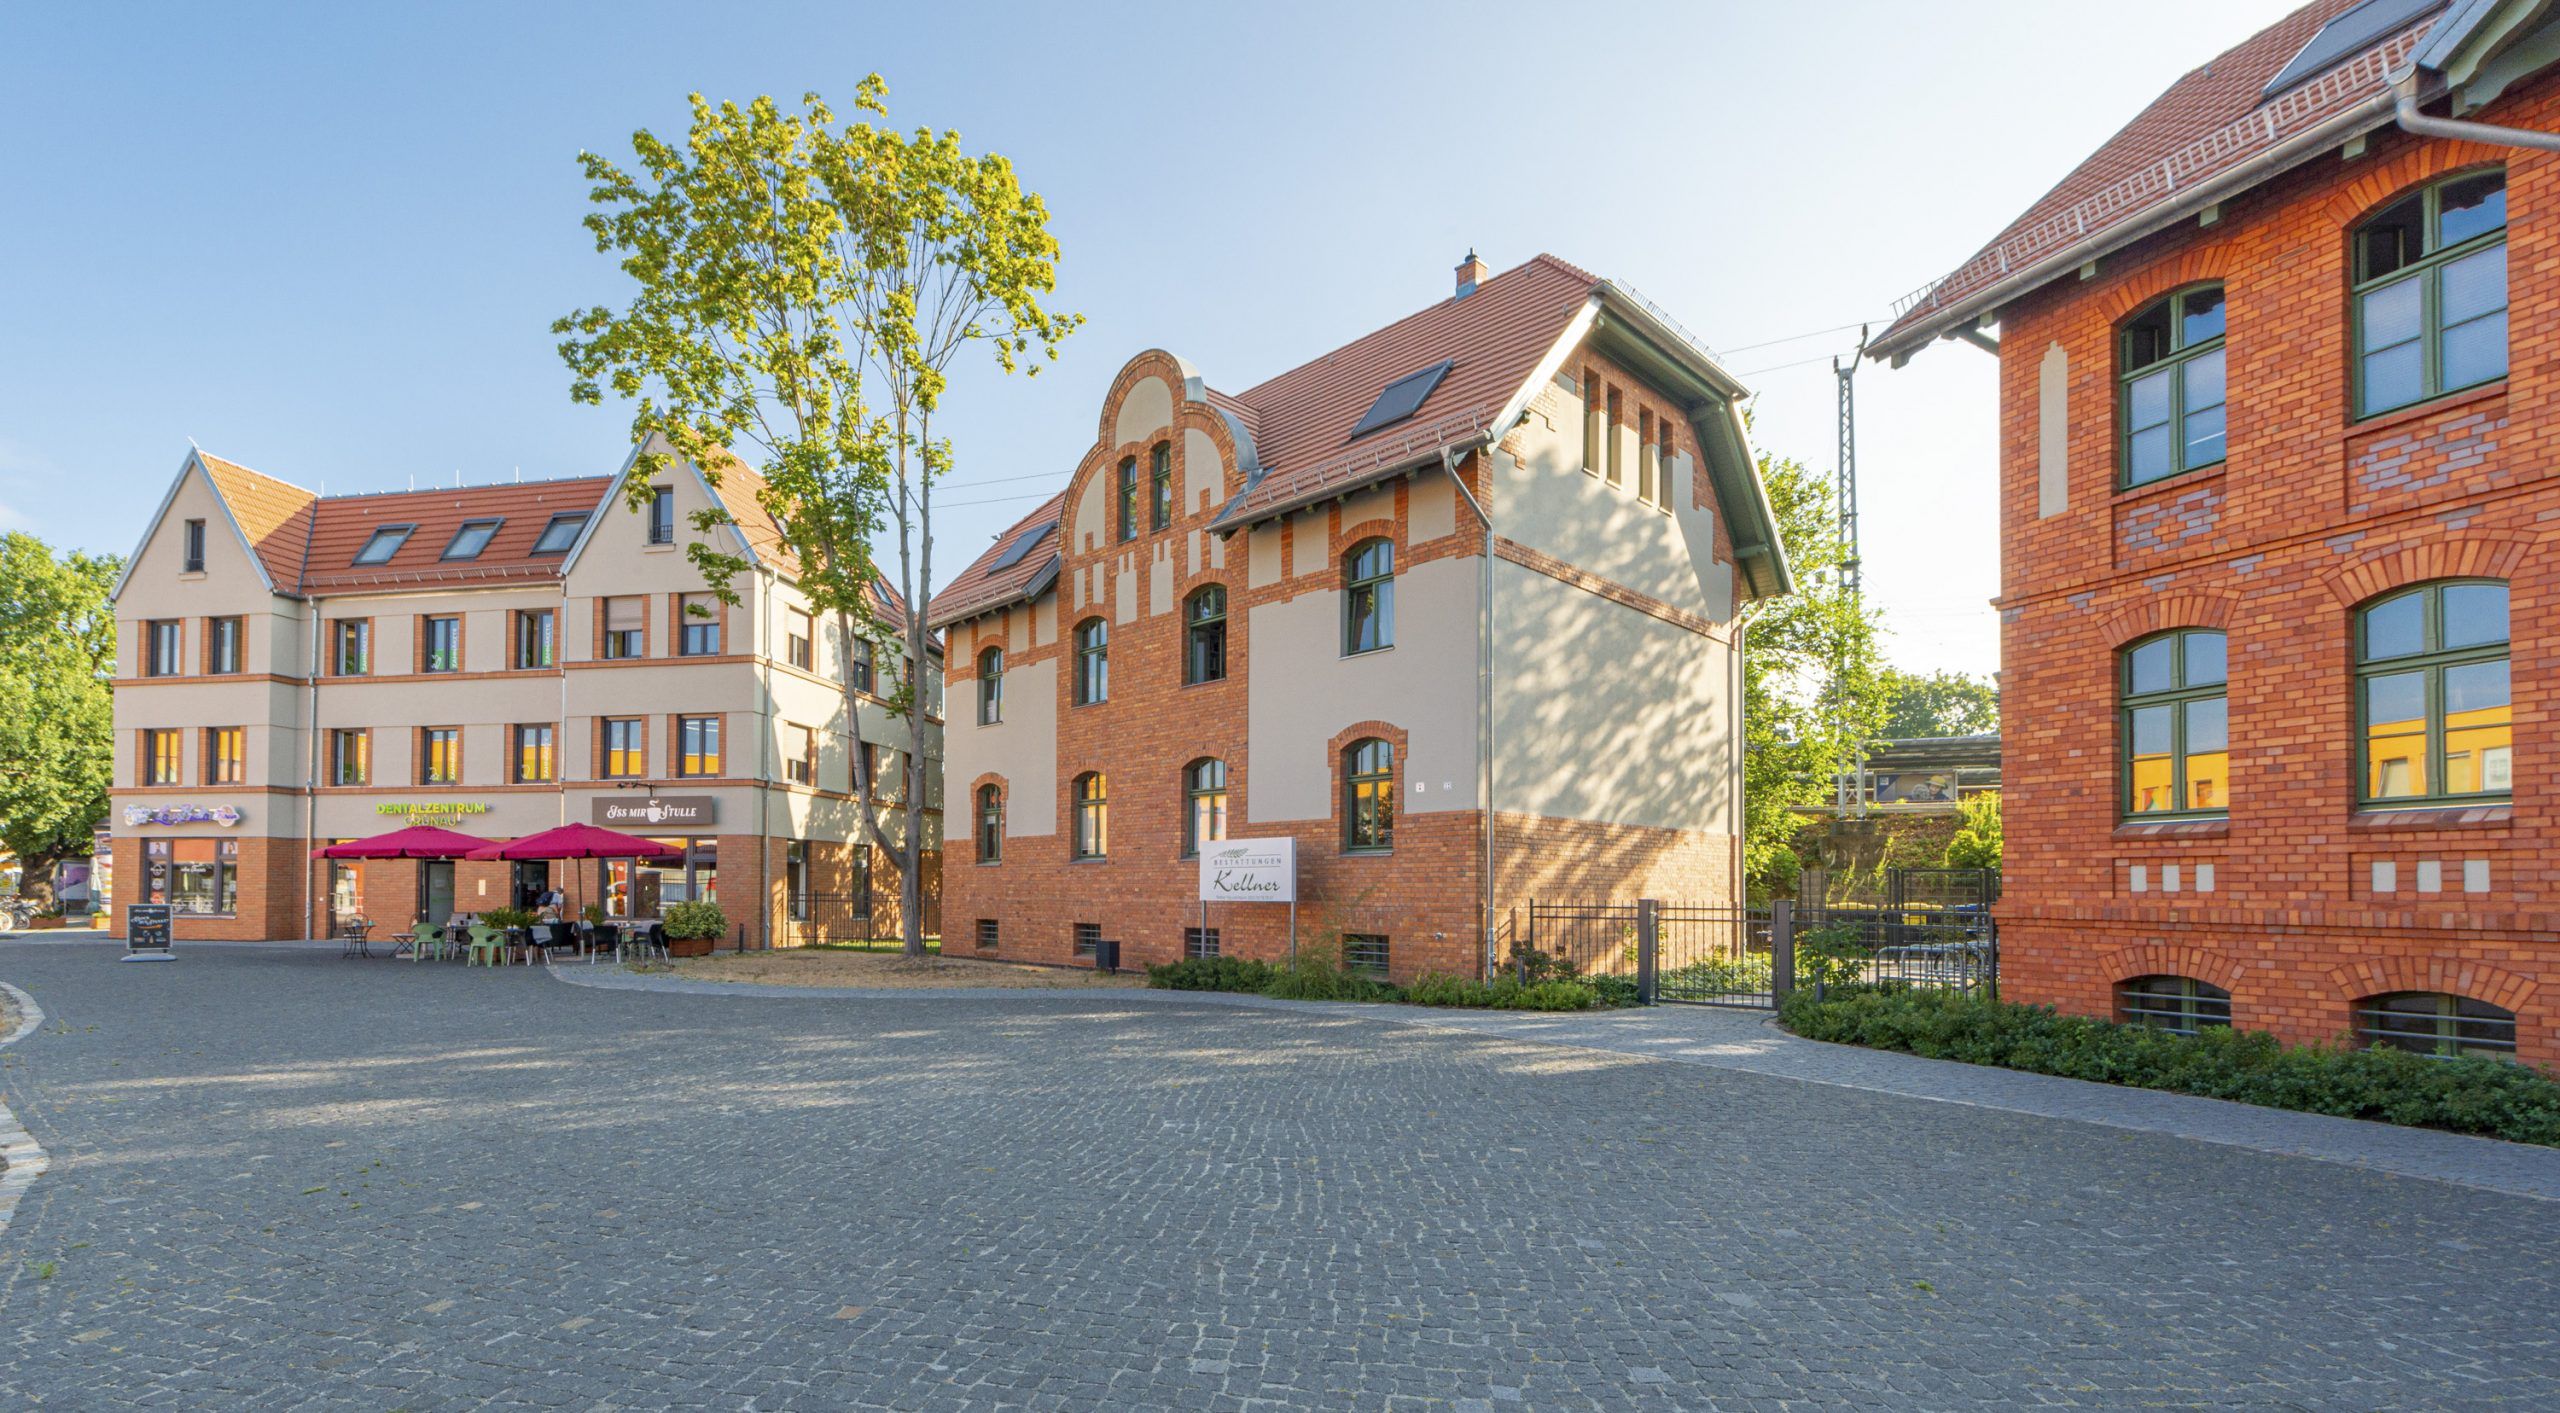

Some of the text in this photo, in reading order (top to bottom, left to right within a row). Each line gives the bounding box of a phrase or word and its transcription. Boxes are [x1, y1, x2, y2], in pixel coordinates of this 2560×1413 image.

[376, 803, 485, 814] DENTALZENTRUM
[403, 815, 457, 827] GRÜNAU
[1213, 858, 1281, 866] BESTATTUNGEN
[1213, 869, 1280, 893] Kellner
